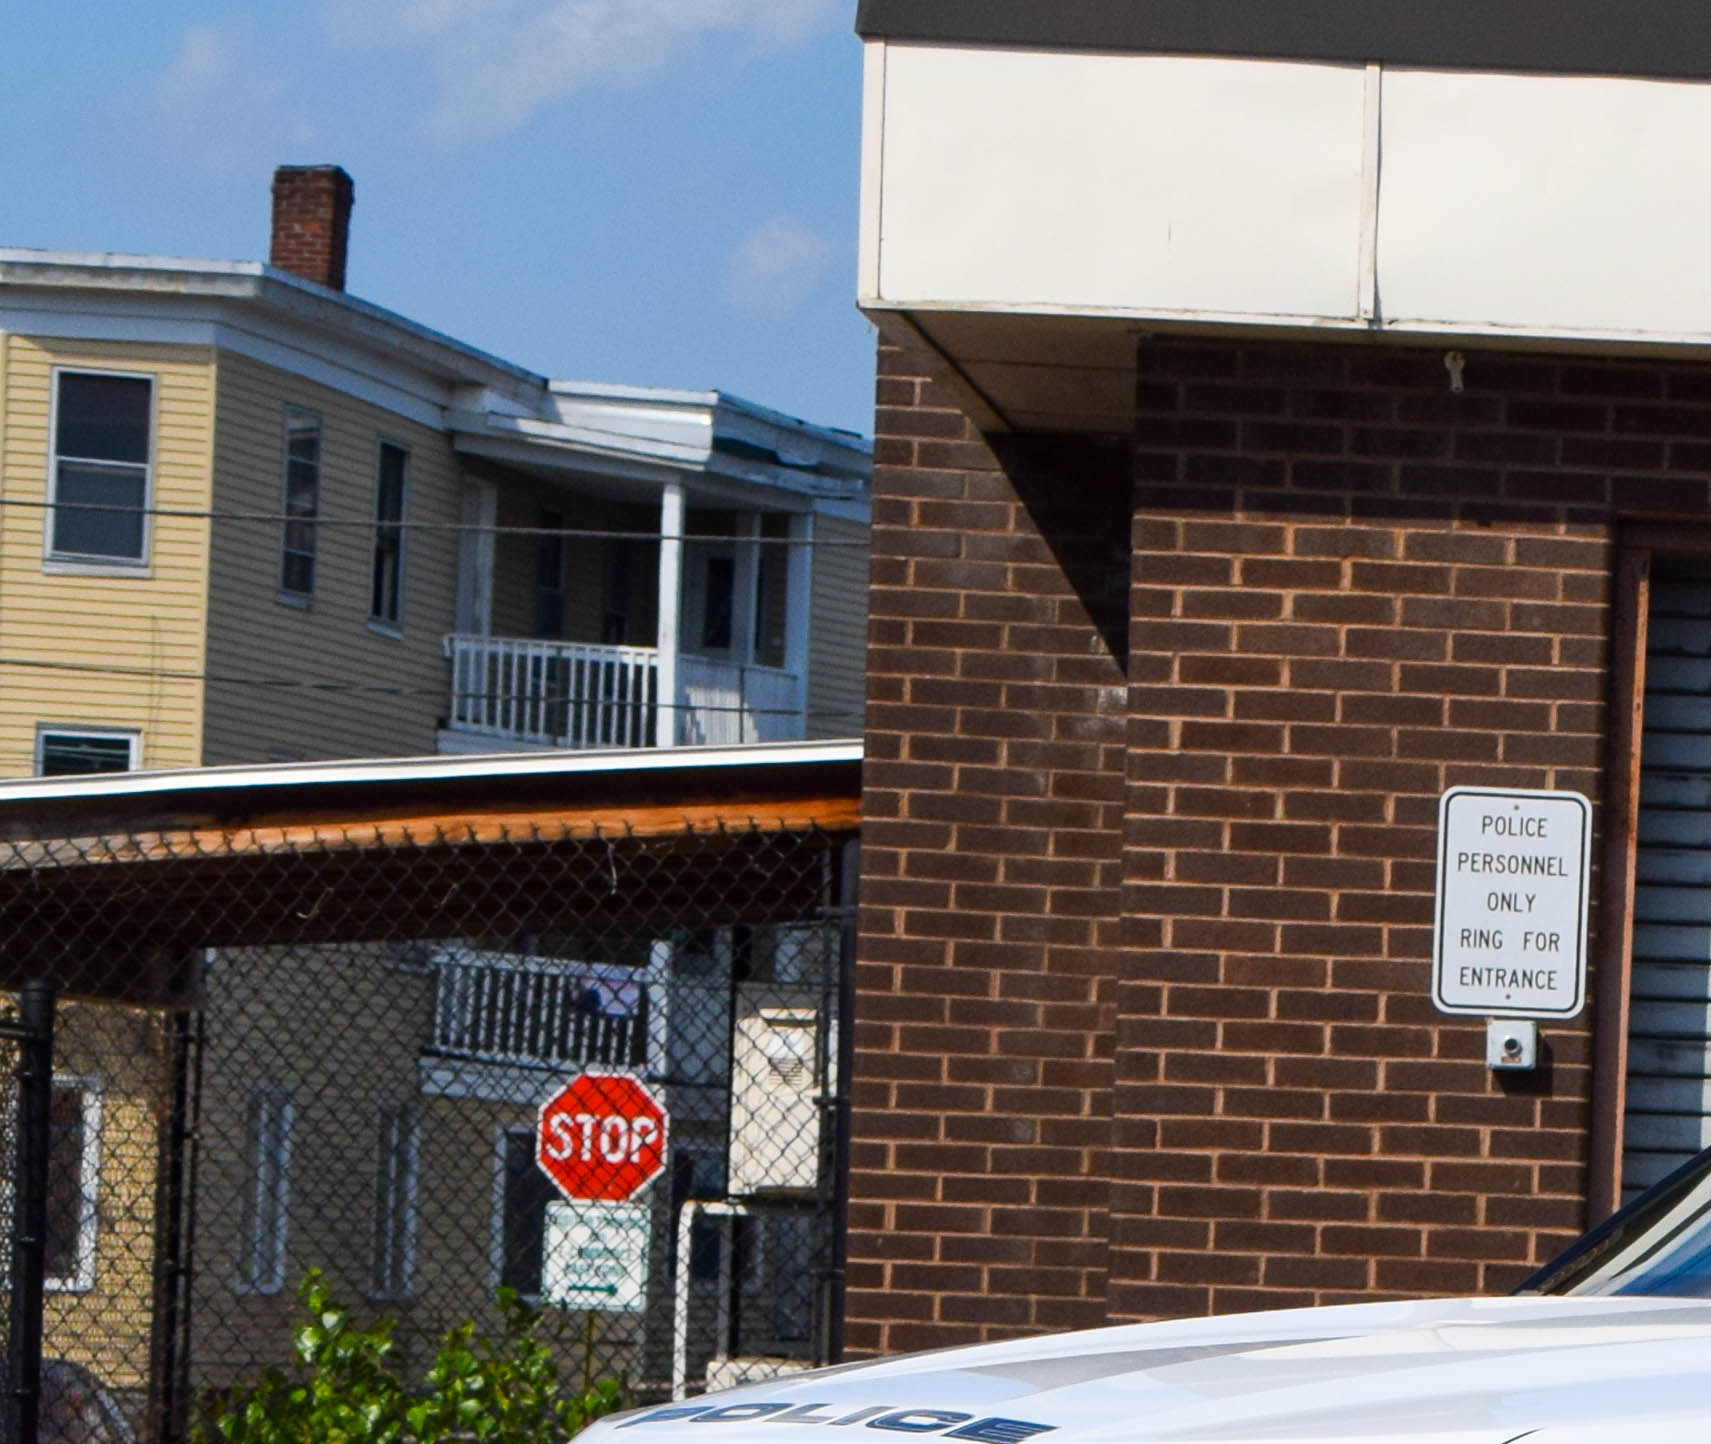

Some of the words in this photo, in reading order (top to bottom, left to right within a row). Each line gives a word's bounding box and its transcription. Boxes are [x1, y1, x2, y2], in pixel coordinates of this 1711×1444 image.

[1482, 815, 1548, 838] POLICE
[1458, 852, 1569, 877] PERSONNEL
[1487, 892, 1537, 913] ONLY
[1460, 928, 1504, 950] RING
[1523, 932, 1560, 952] FOR
[1459, 966, 1558, 990] ENTRANCE
[546, 1112, 658, 1164] STOP
